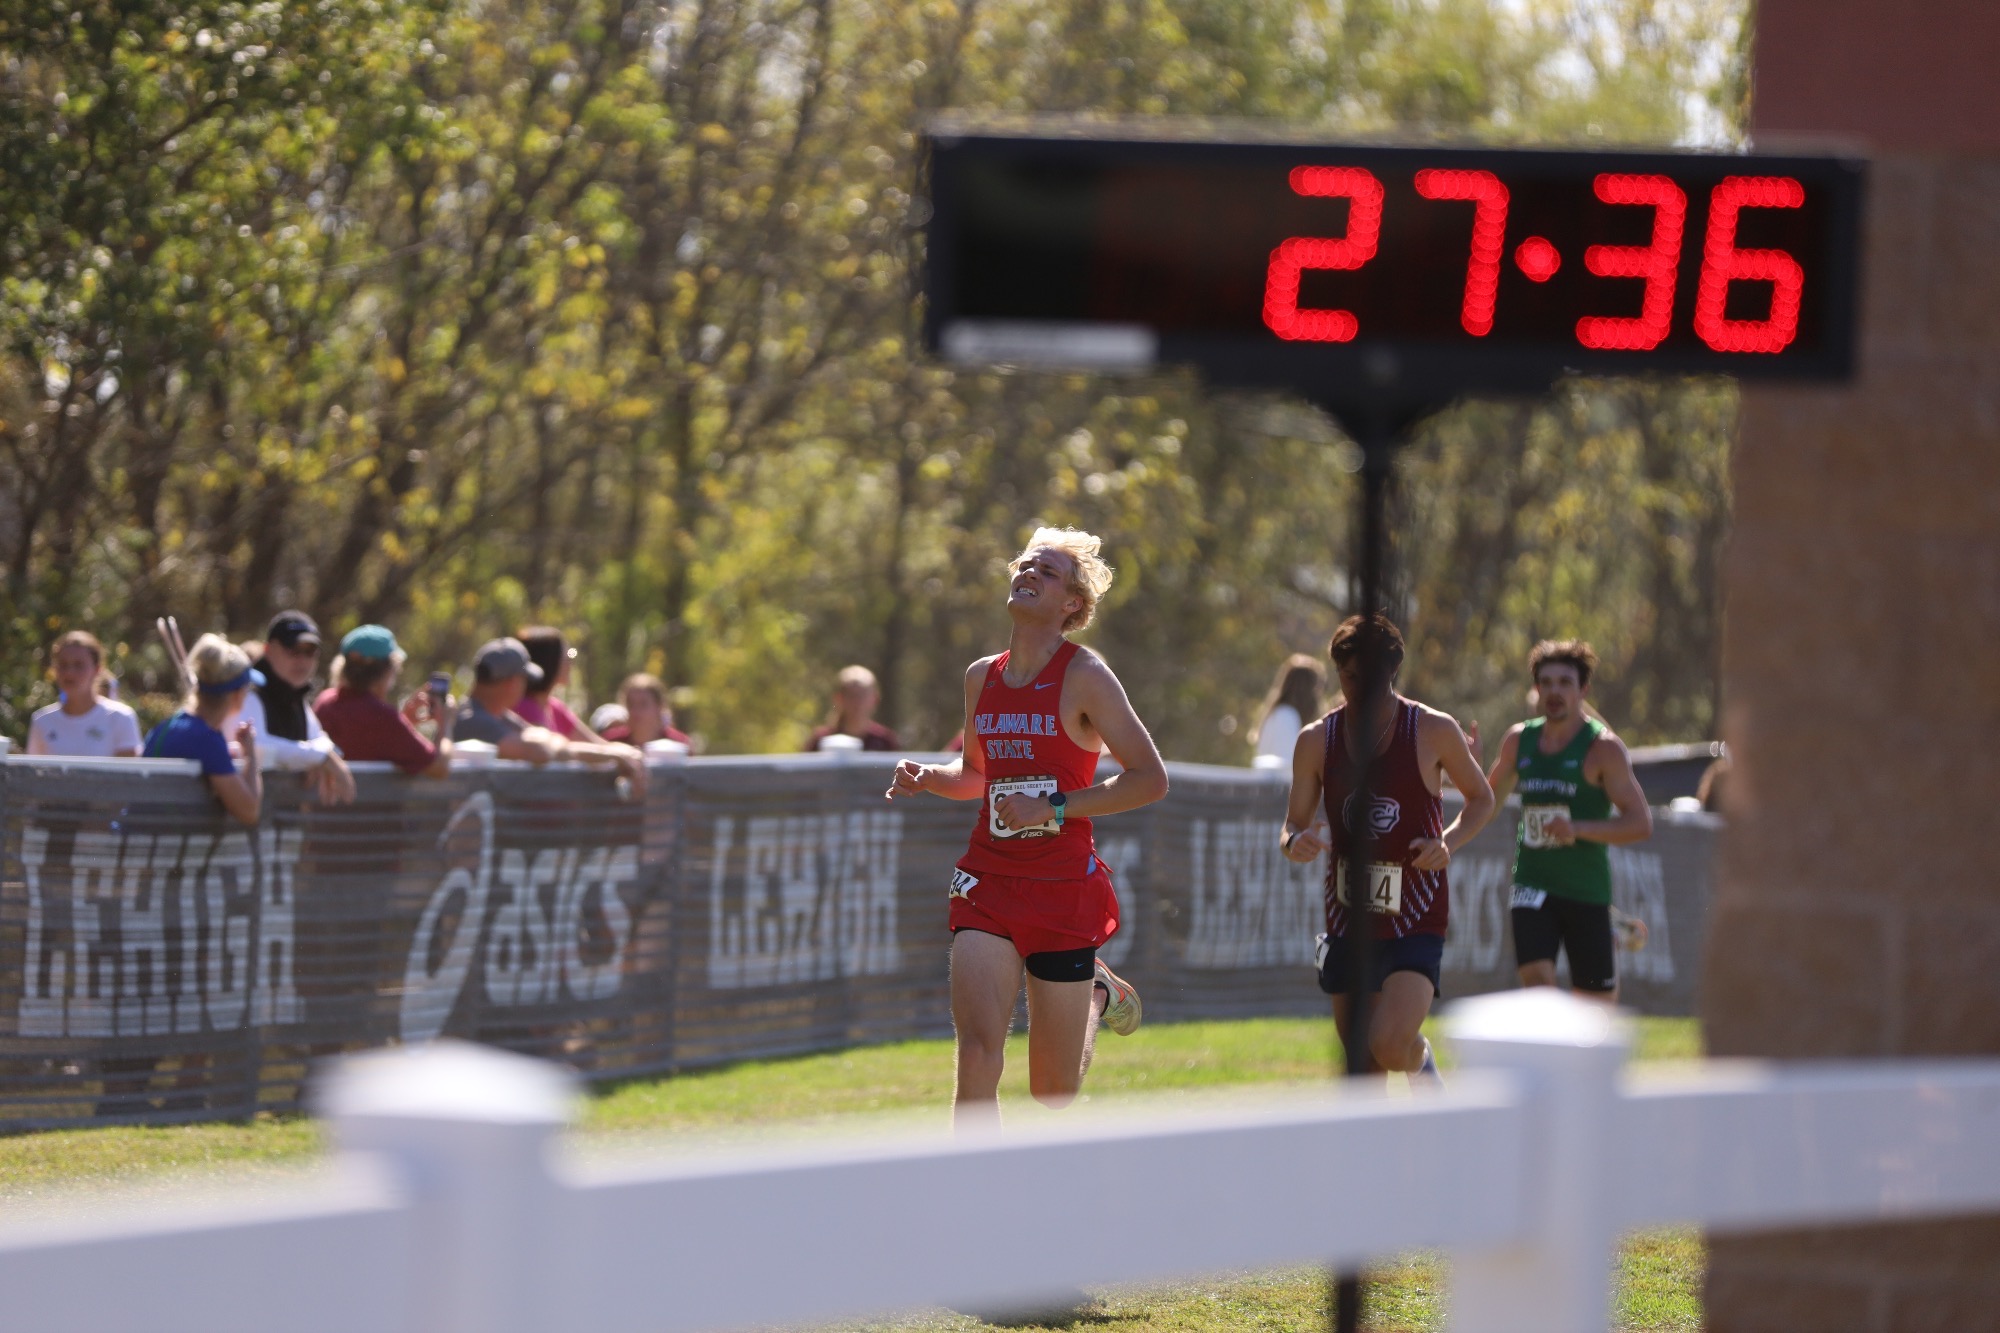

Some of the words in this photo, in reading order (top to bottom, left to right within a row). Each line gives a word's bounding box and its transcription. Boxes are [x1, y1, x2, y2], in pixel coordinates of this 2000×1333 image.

[975, 713, 1057, 736] DELAWARE
[986, 739, 1035, 760] STATE
[18, 828, 305, 1038] LEHIGH
[707, 811, 905, 990] LEHIGH
